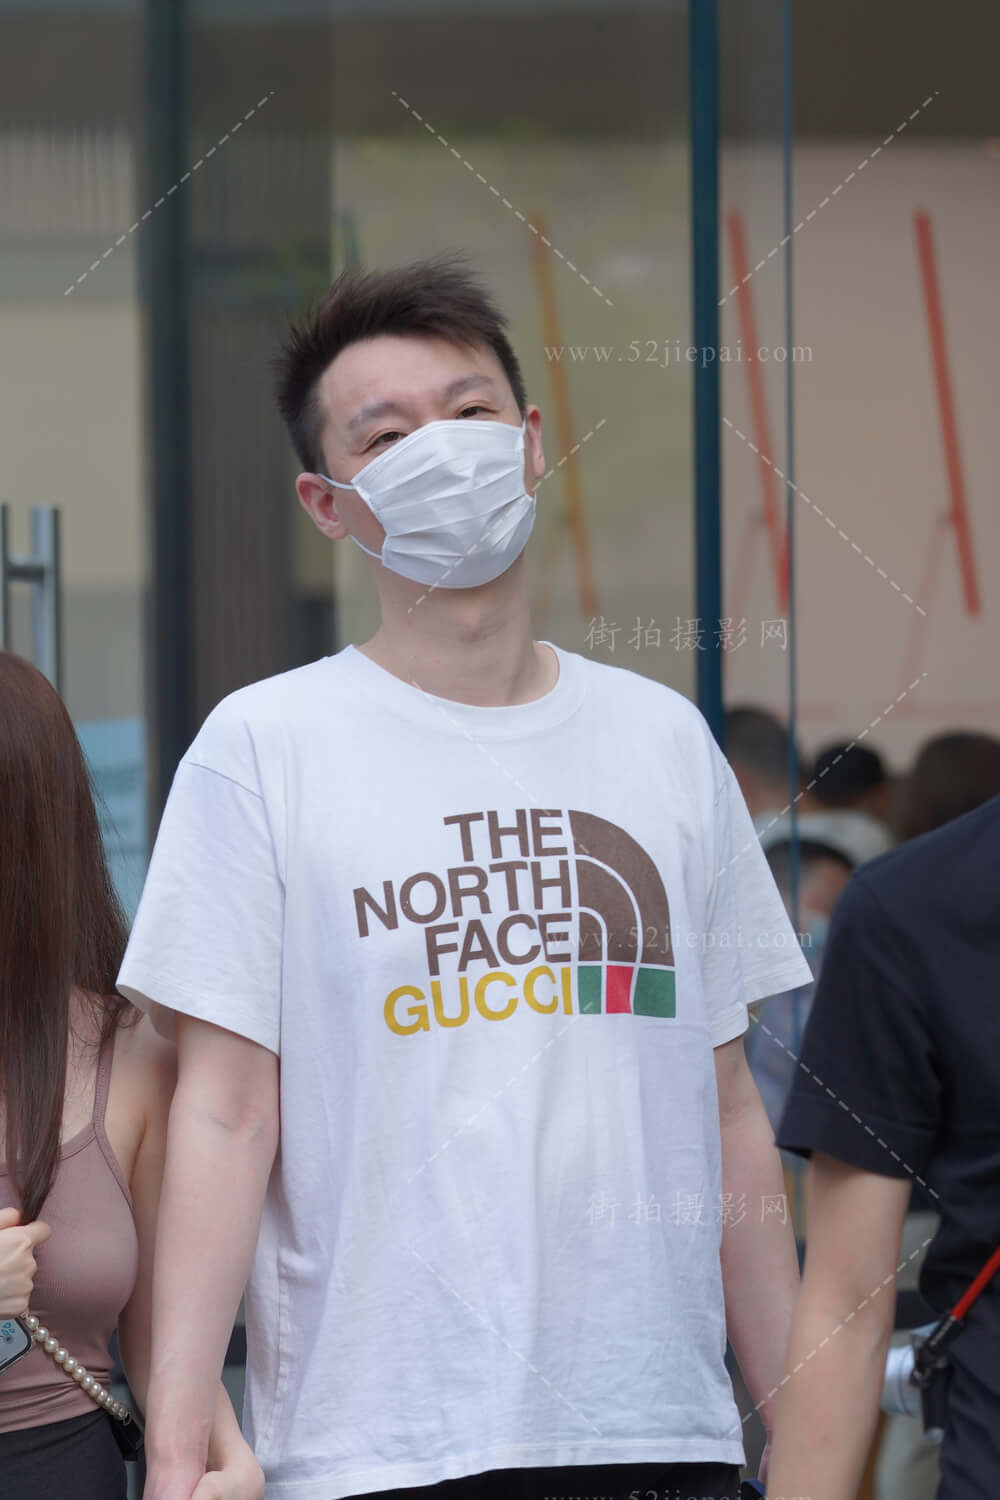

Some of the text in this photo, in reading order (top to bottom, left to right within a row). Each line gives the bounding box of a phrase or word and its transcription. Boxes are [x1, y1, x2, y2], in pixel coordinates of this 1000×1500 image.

[443, 808, 568, 862] THE
[353, 859, 572, 938] NORTH
[424, 912, 572, 976] FACE
[384, 965, 573, 1036] GUCCI
